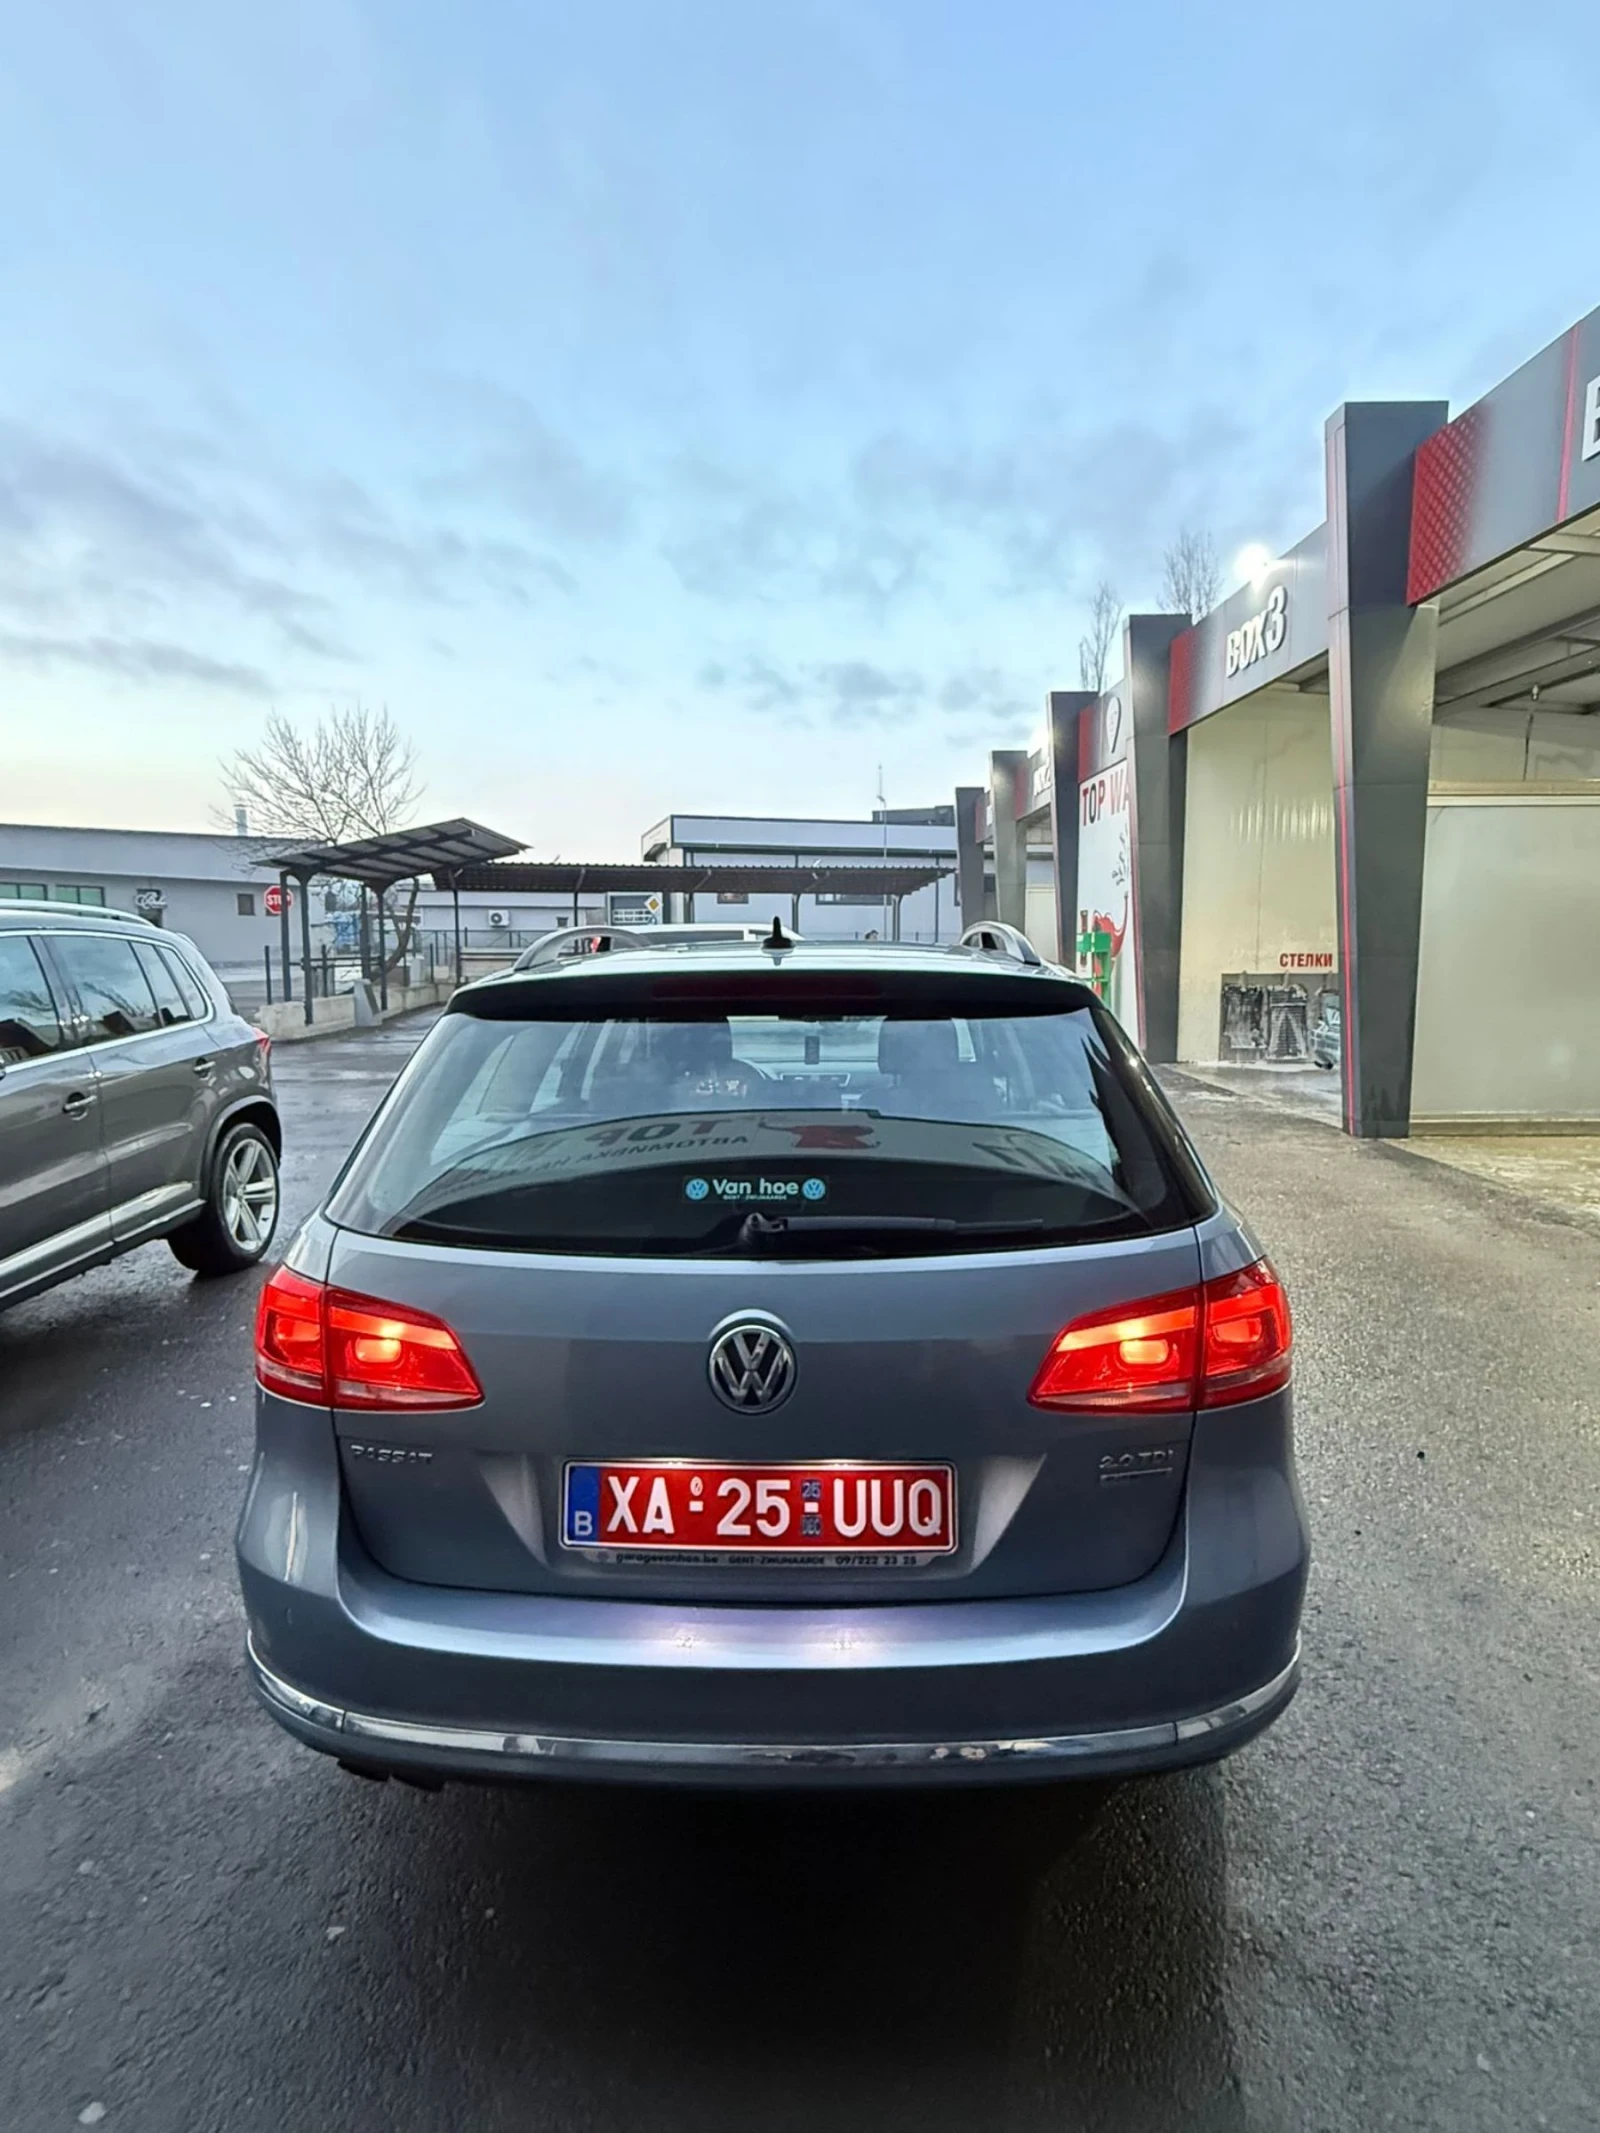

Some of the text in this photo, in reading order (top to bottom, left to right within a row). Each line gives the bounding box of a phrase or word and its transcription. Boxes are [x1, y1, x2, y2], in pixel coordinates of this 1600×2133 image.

[1083, 779, 1105, 826] TOP
[1280, 953, 1333, 967] СТЕЛКИ
[713, 1178, 798, 1194] Van hoe
[574, 1511, 593, 1536] B
